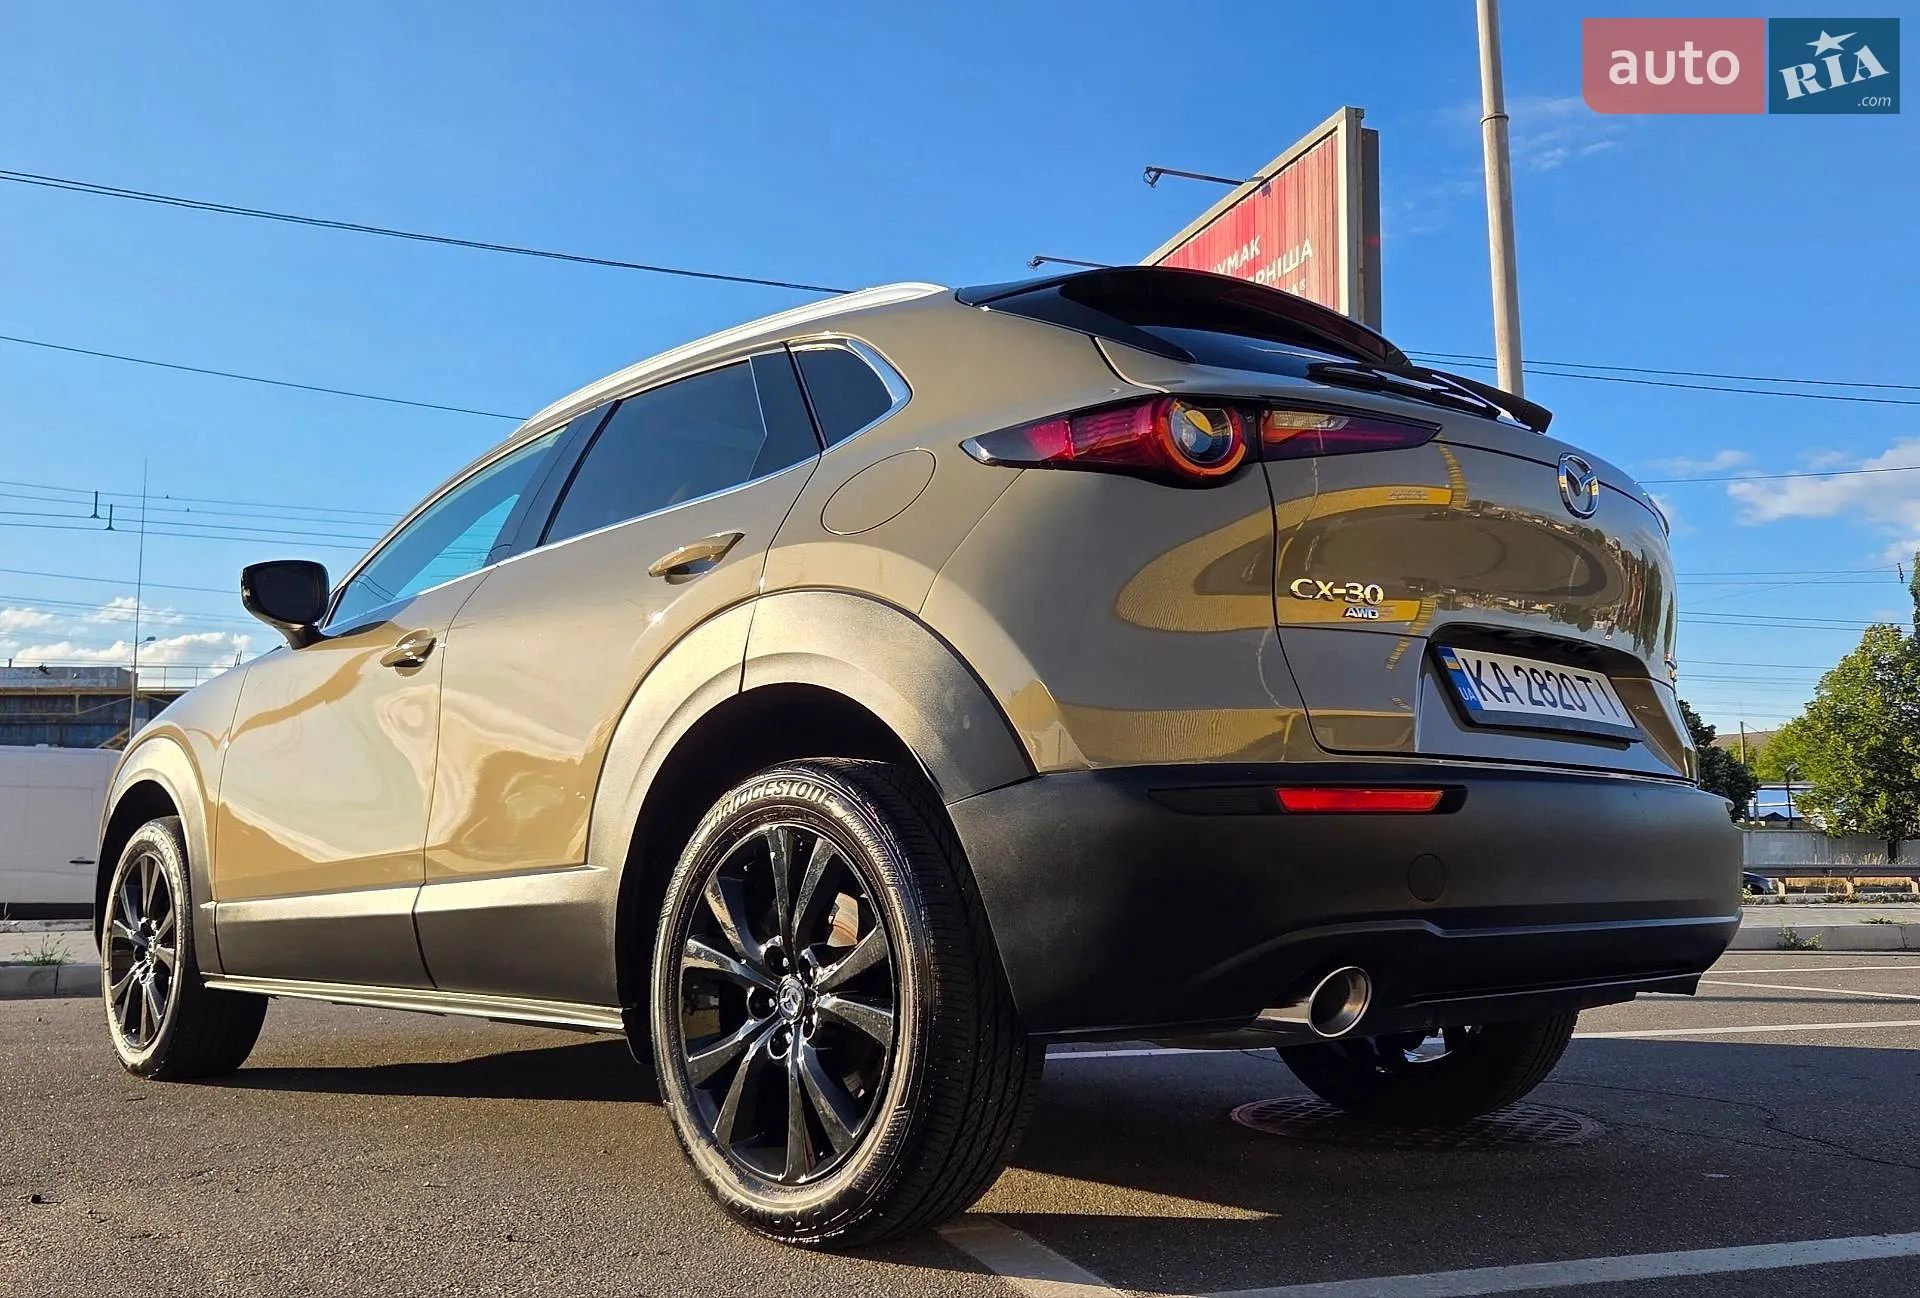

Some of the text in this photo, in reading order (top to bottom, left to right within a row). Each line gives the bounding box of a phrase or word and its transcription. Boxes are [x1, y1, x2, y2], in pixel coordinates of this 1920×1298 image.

[1213, 234, 1261, 274] УМАК
[1246, 238, 1313, 285] РНІША
[1290, 578, 1384, 605] CX-30
[1343, 606, 1380, 619] AWD
[1458, 686, 1477, 702] UA
[706, 779, 839, 831] BRIDGESTONE
